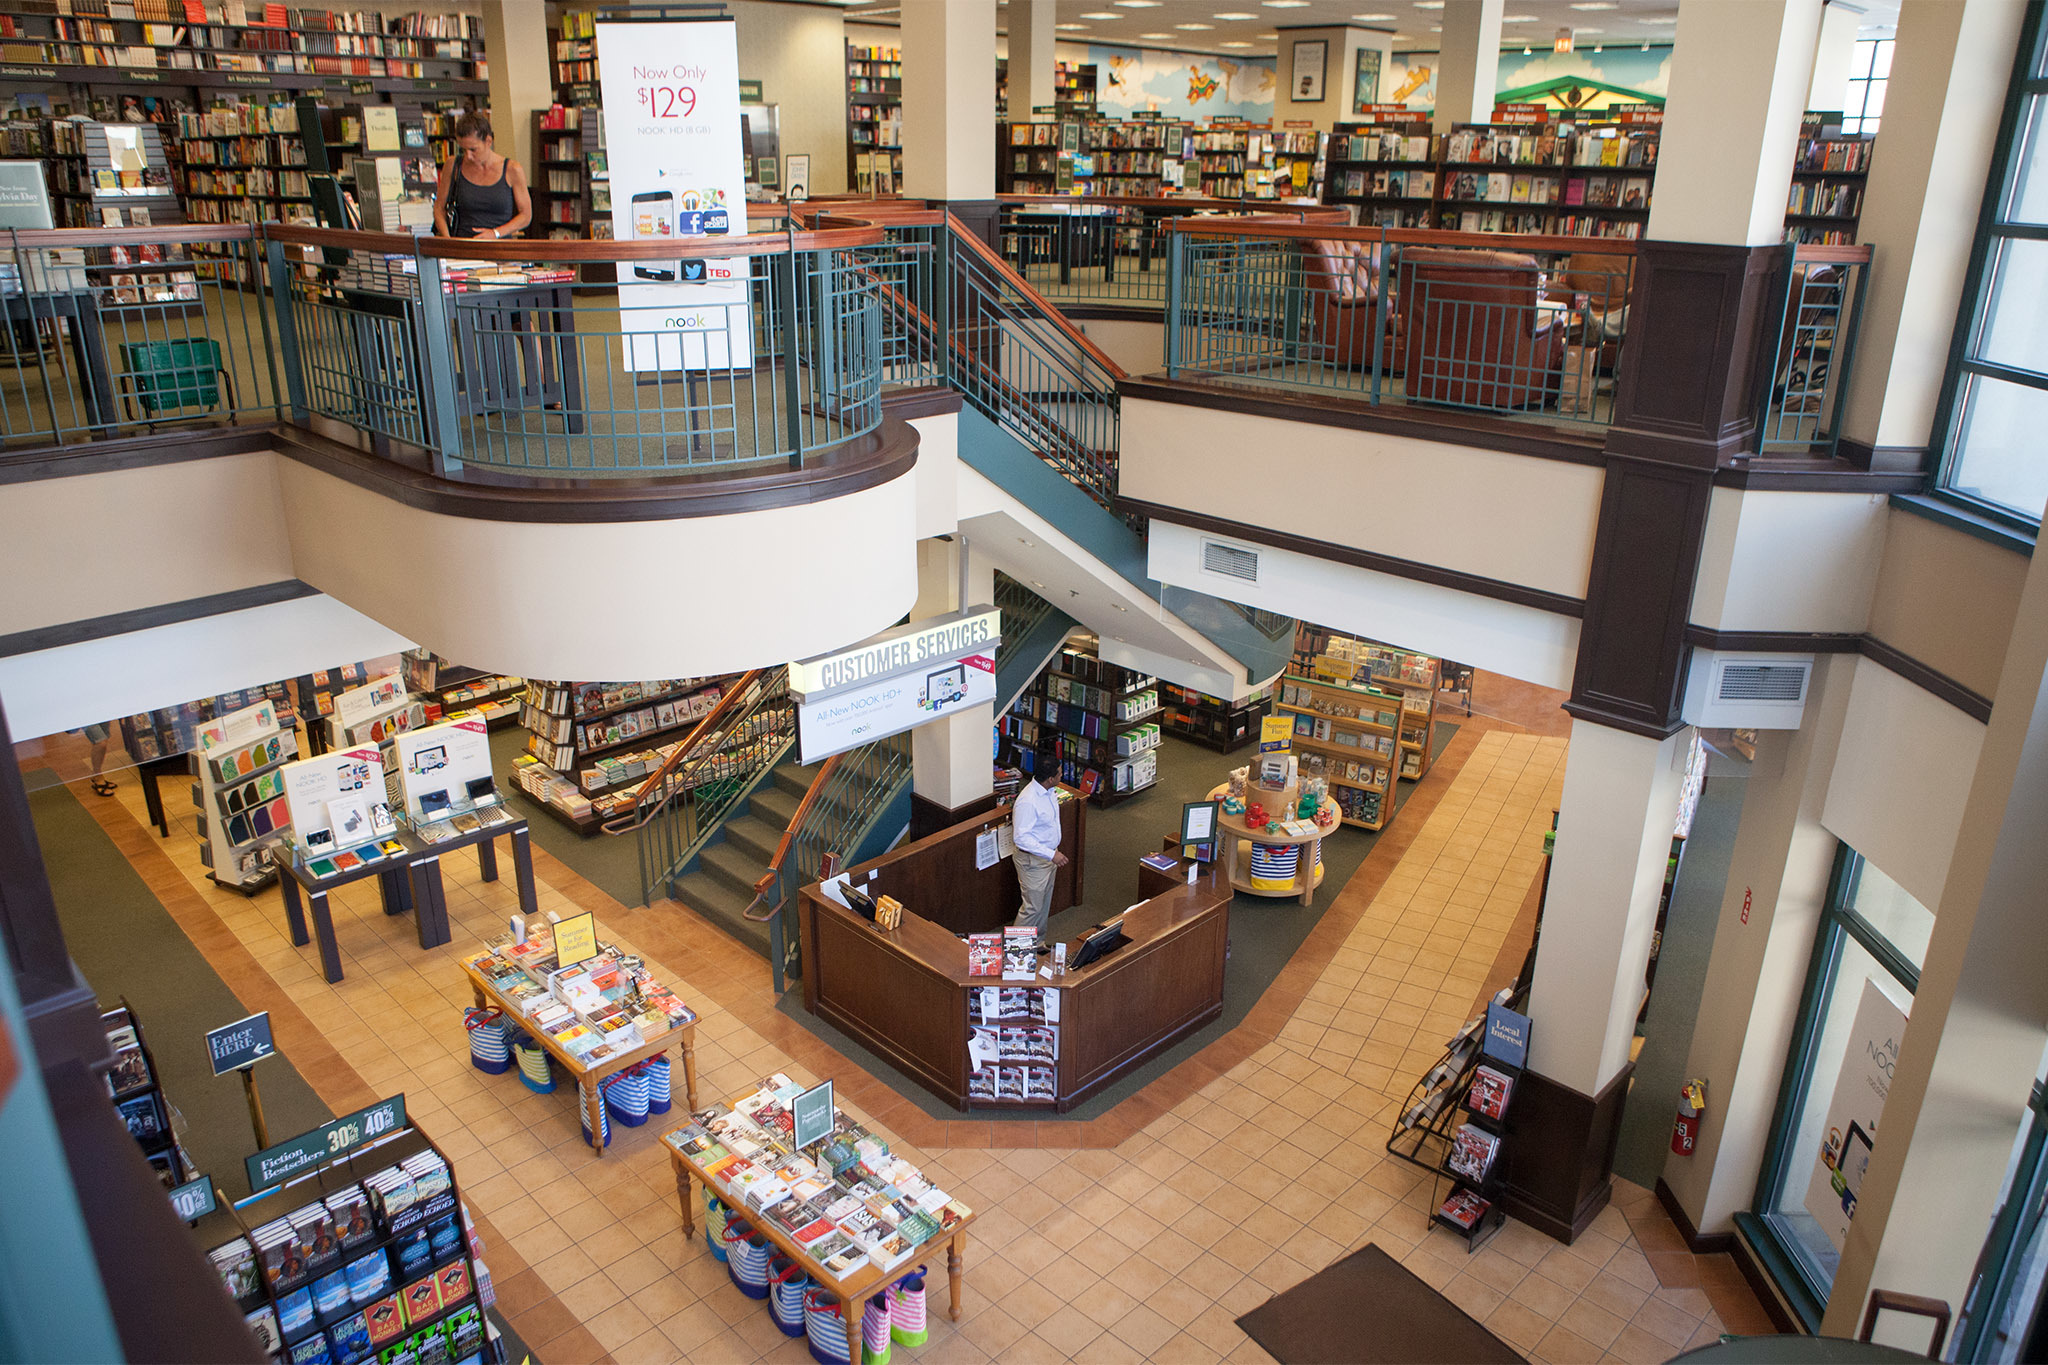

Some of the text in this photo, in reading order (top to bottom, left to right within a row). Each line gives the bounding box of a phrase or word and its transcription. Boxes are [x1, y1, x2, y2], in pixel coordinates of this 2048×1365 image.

[633, 65, 707, 82] Now Only
[637, 86, 696, 118] $129
[1503, 114, 1537, 122] New Releases
[1632, 113, 1644, 122] New
[669, 126, 684, 135] HD
[708, 268, 731, 278] TED
[666, 313, 706, 328] nook
[821, 618, 988, 690] CUSTOMER SERVICES
[816, 706, 849, 722] All-New
[850, 694, 880, 711] NOOK
[882, 688, 902, 700] HD+
[851, 722, 872, 735] nook
[561, 926, 588, 938] Summer
[564, 940, 590, 952] Reading
[1496, 1019, 1520, 1037] Local
[211, 1028, 252, 1050] Enter
[1491, 1026, 1522, 1048] Interest
[214, 1035, 256, 1060] HERE
[1866, 1040, 1896, 1080] NOO
[364, 1108, 394, 1136] 40%
[384, 1116, 394, 1126] OFF
[1679, 1124, 1686, 1135] 5
[328, 1122, 359, 1152] 30%
[350, 1132, 359, 1142] OFF
[1684, 1137, 1691, 1149] 2
[261, 1148, 303, 1170] Fiction
[264, 1150, 325, 1181] Bestsellers
[195, 1199, 206, 1209] OFF
[423, 1198, 455, 1217] ECHOED
[391, 1213, 423, 1234] ECHOED
[435, 1241, 460, 1256] GAIMAN
[404, 1256, 430, 1271] GAIMAN
[444, 1286, 470, 1304] MONKEY
[447, 1283, 464, 1296] BAD
[412, 1302, 439, 1321] MONKEY
[416, 1300, 433, 1313] BAD
[336, 1319, 366, 1341] HAMILTON
[372, 1323, 401, 1342] MONKEY
[377, 1320, 395, 1333] BAD
[452, 1321, 479, 1340] Evanovich
[458, 1319, 474, 1332] Janet
[418, 1335, 446, 1354] Evanovich
[423, 1333, 439, 1346] Janet
